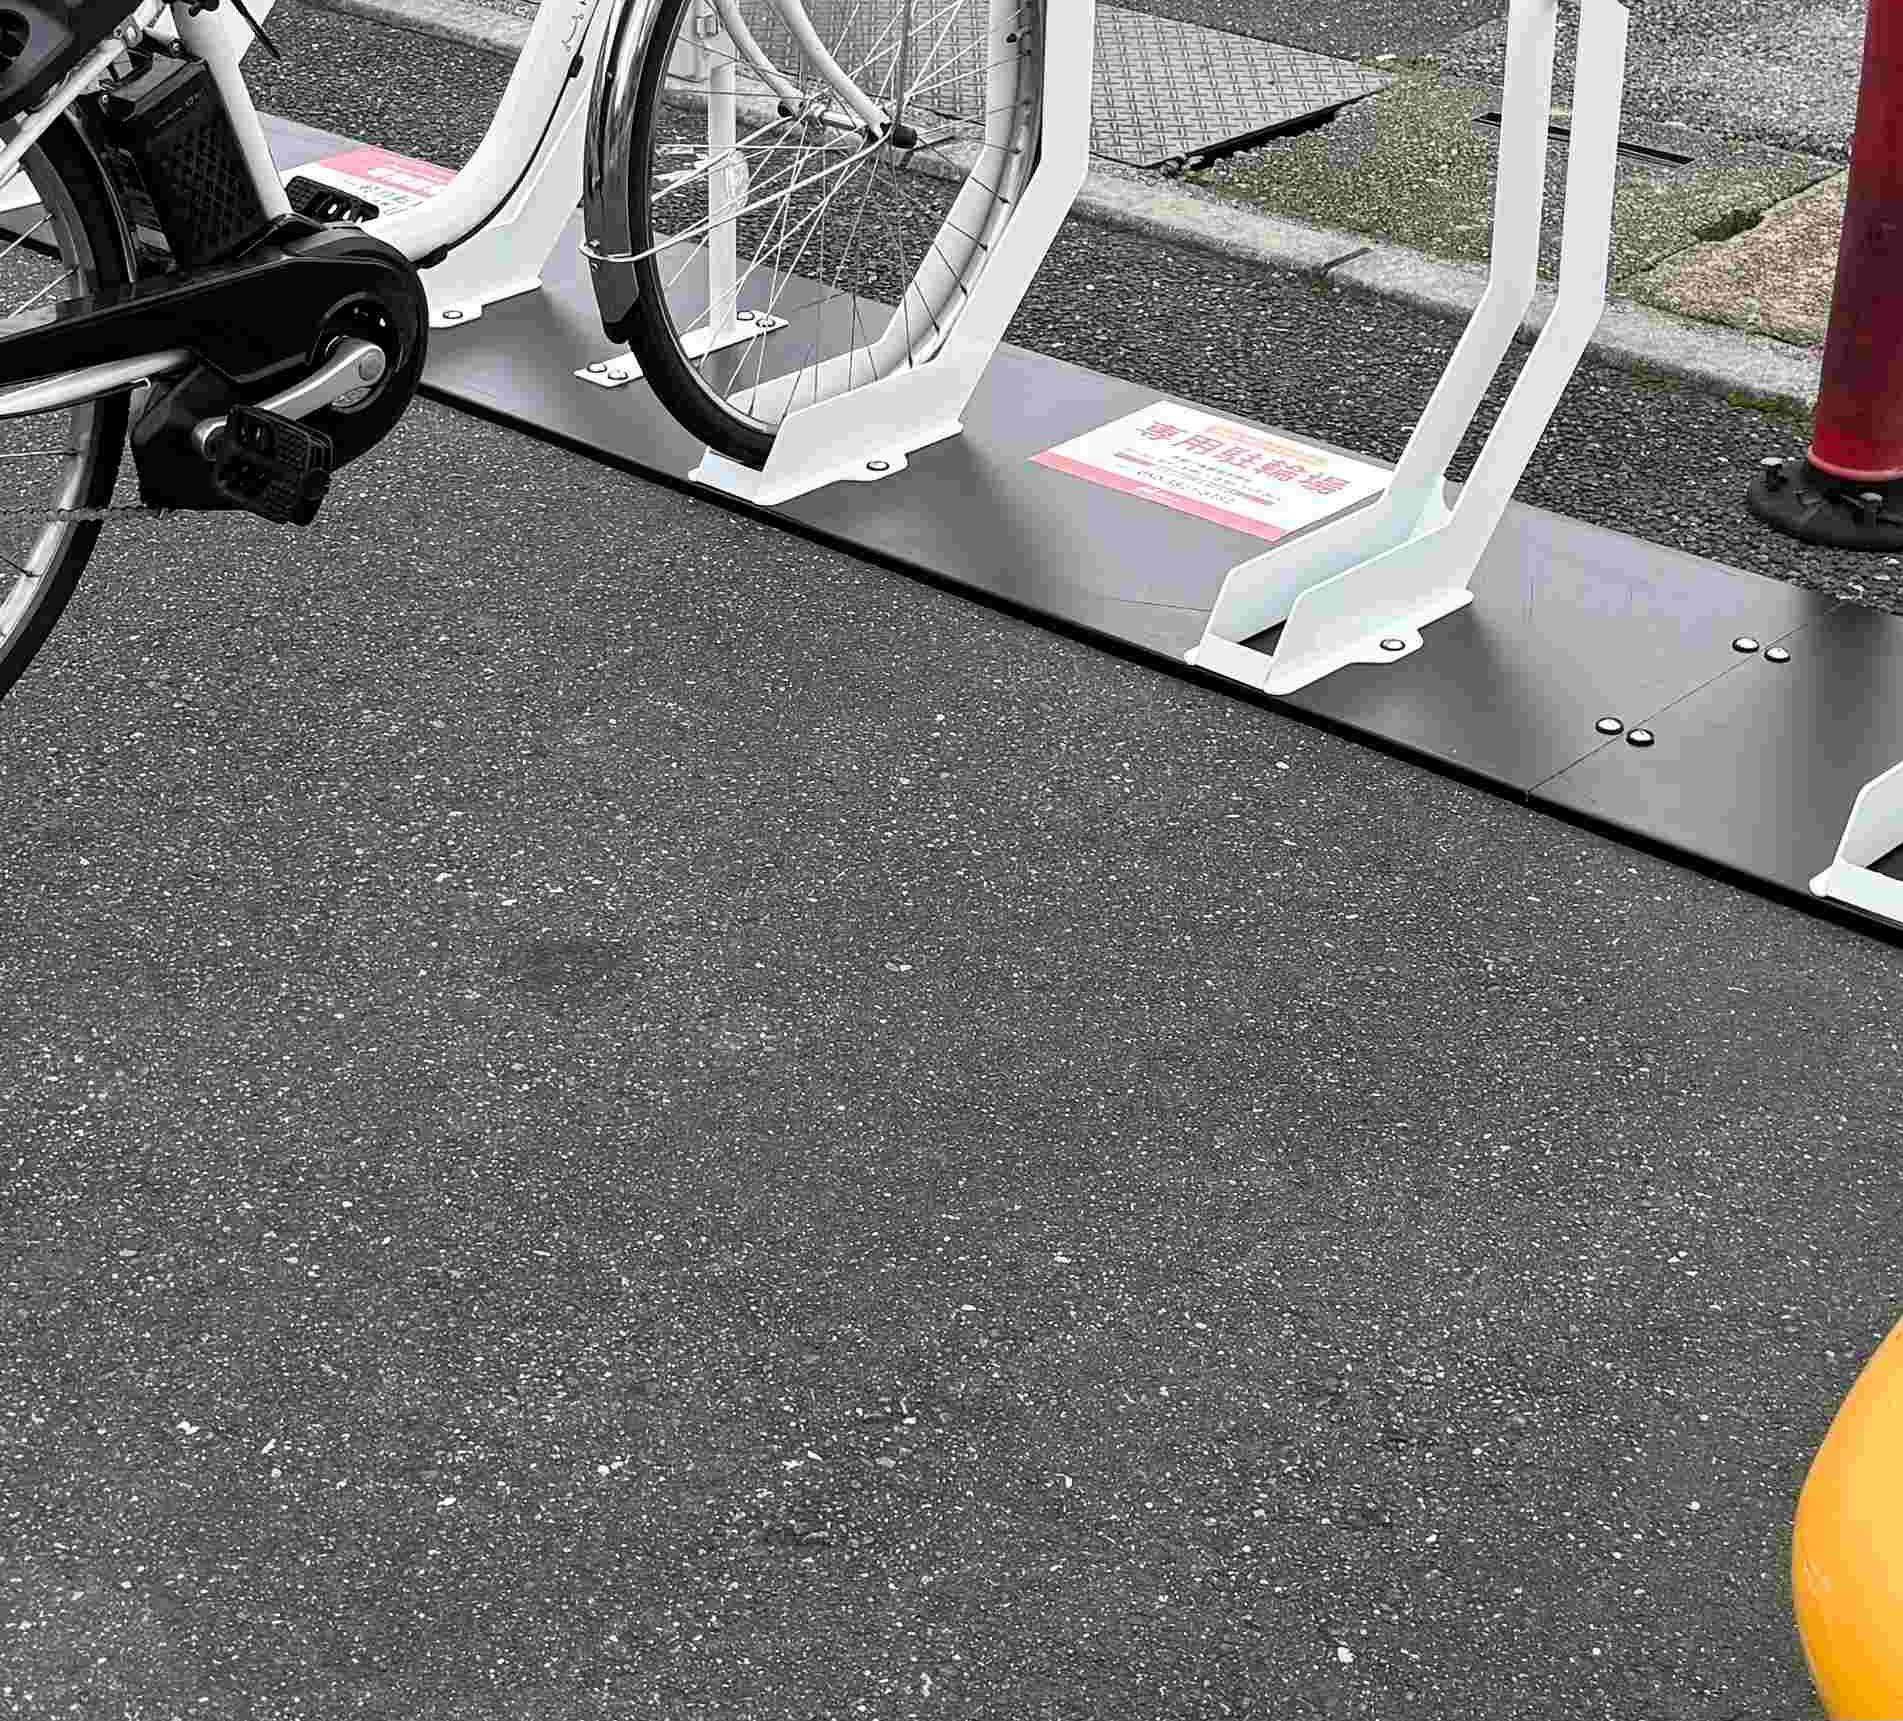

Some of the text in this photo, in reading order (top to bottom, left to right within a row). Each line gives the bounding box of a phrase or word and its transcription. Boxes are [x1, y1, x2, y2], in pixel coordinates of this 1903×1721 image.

[1136, 421, 1351, 495] 専用駐輪場
